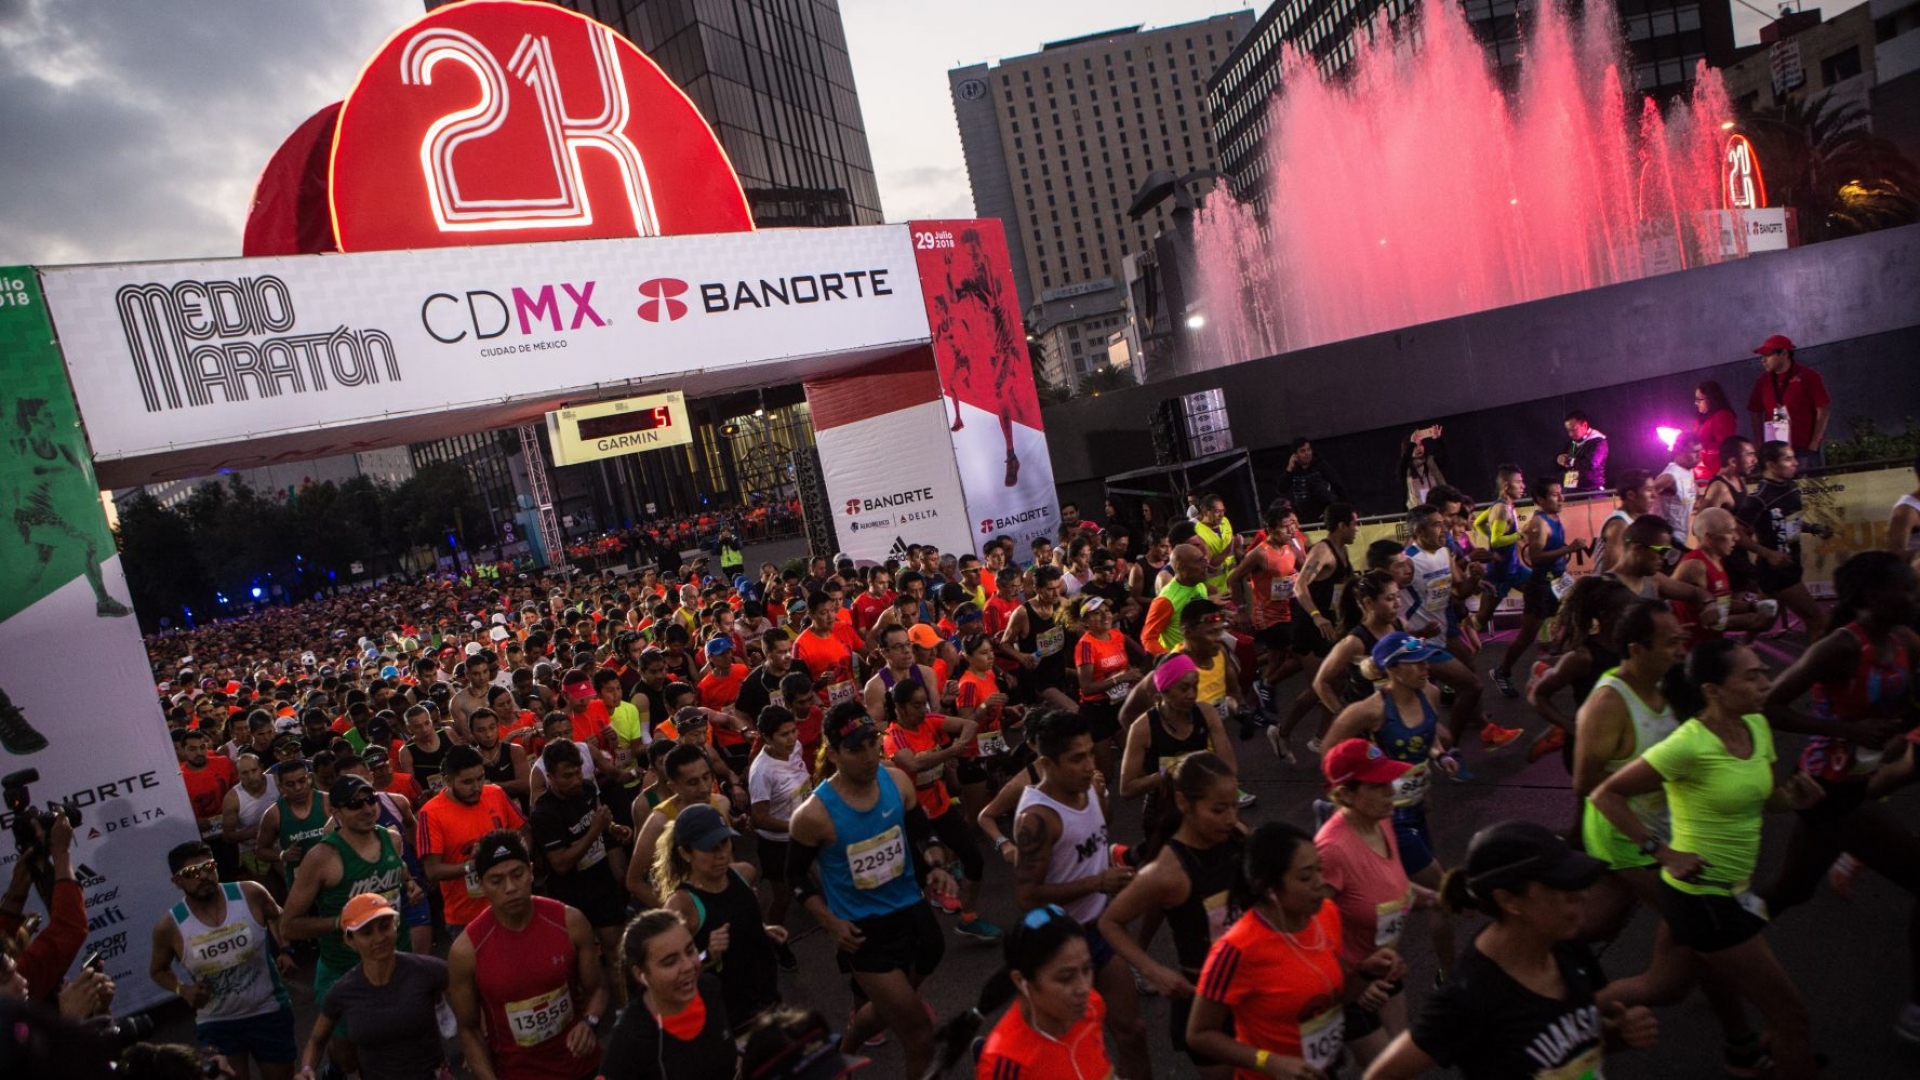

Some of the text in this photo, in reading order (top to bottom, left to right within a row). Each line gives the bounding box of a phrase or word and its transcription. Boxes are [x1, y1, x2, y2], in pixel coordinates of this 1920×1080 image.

[400, 18, 660, 237] 21K
[915, 231, 935, 250] 29
[935, 239, 955, 248] 2018
[700, 269, 893, 314] BANORTE
[480, 339, 568, 357] CIUDAD DE MÉXICO
[654, 407, 667, 428] 5
[597, 431, 658, 452] GARMIN
[864, 487, 934, 511] BANORTE
[908, 509, 938, 522] DELTA
[996, 506, 1050, 529] BANORTE
[106, 807, 165, 832] DELTA
[853, 840, 902, 874] 22934
[86, 931, 128, 955] SPORT
[98, 942, 128, 961] CITY
[199, 934, 247, 960] 16910
[514, 998, 569, 1030] 13858
